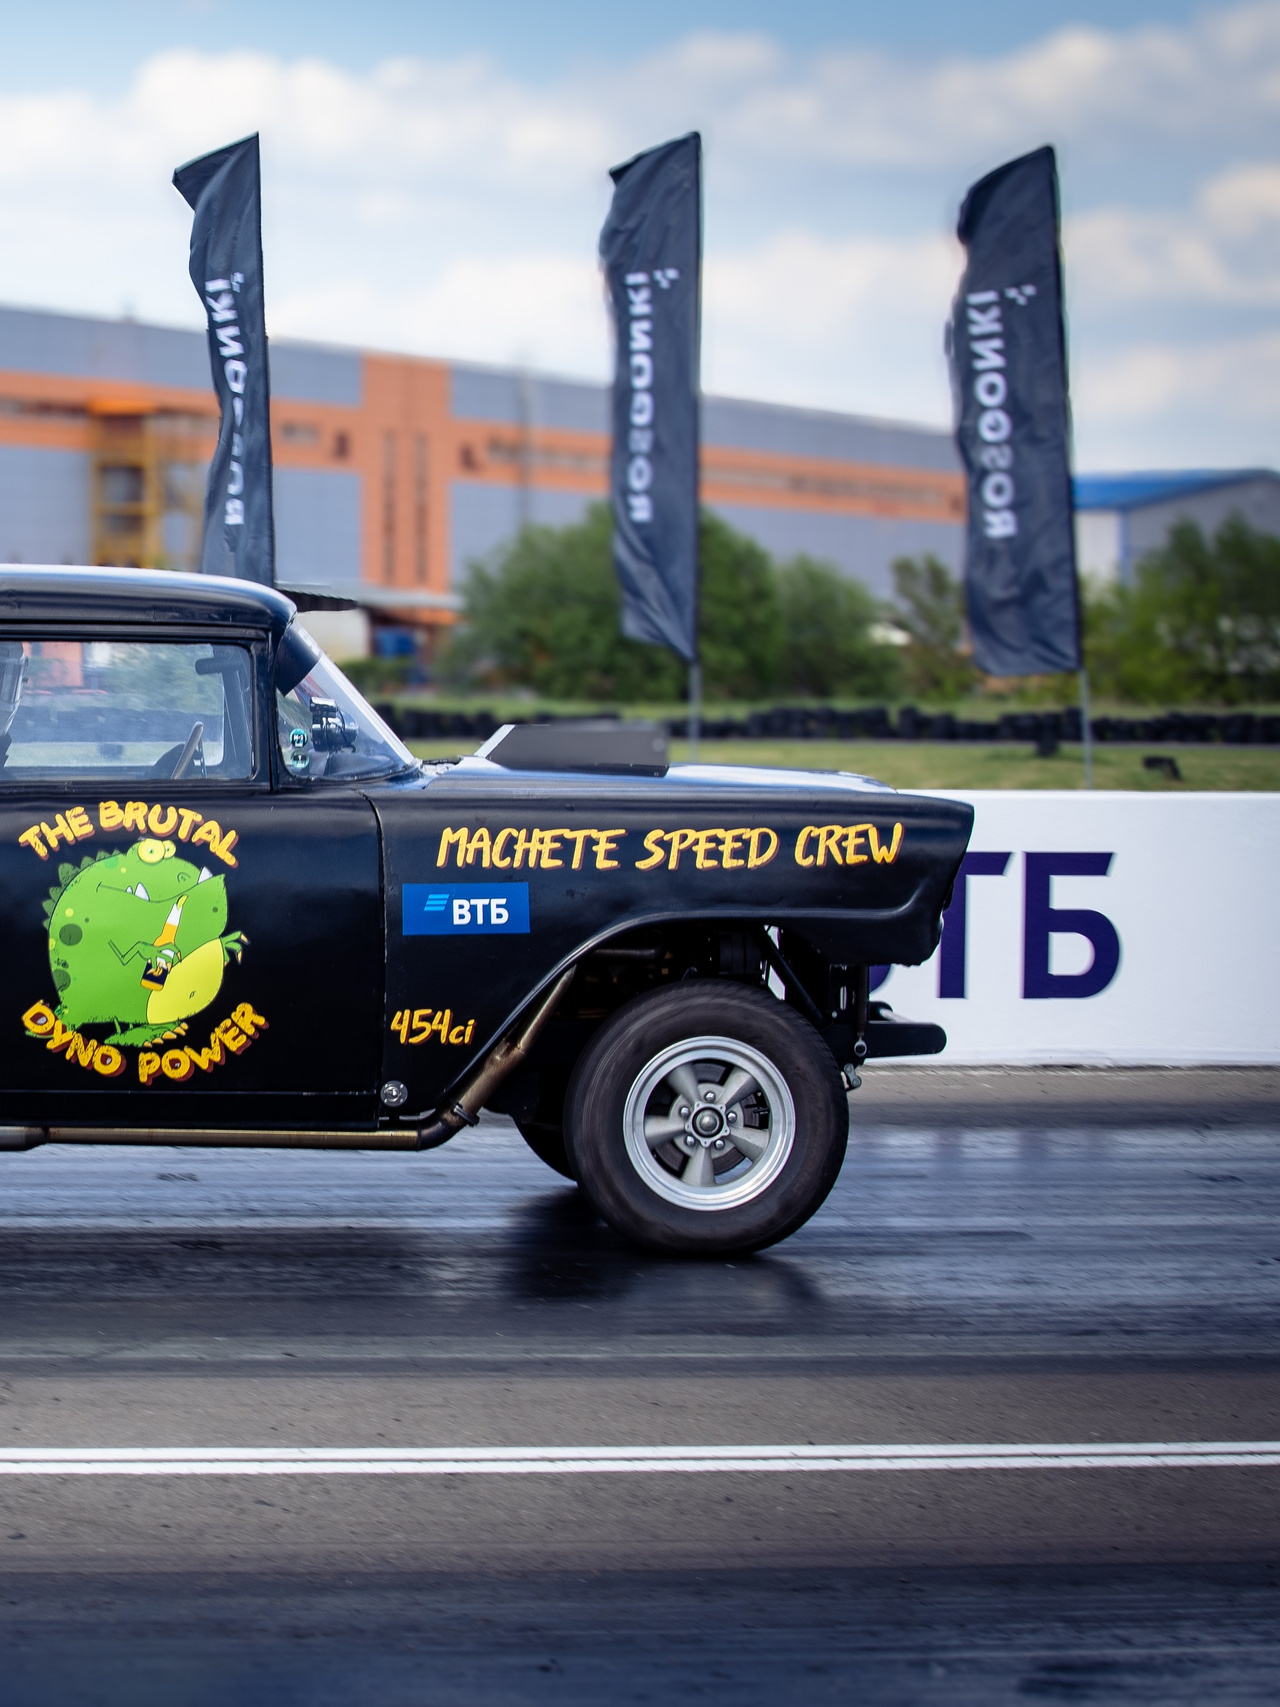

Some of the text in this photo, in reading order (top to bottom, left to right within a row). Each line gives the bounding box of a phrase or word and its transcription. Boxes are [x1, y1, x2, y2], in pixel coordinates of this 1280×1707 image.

[19, 801, 239, 868] THE BRUTAL
[436, 822, 904, 869] MACHETE SPEED CREW
[452, 898, 509, 926] ВТБ
[869, 851, 1122, 999] ТБ
[21, 1000, 269, 1084] DYNO POWER
[390, 1008, 477, 1045] 454ci
